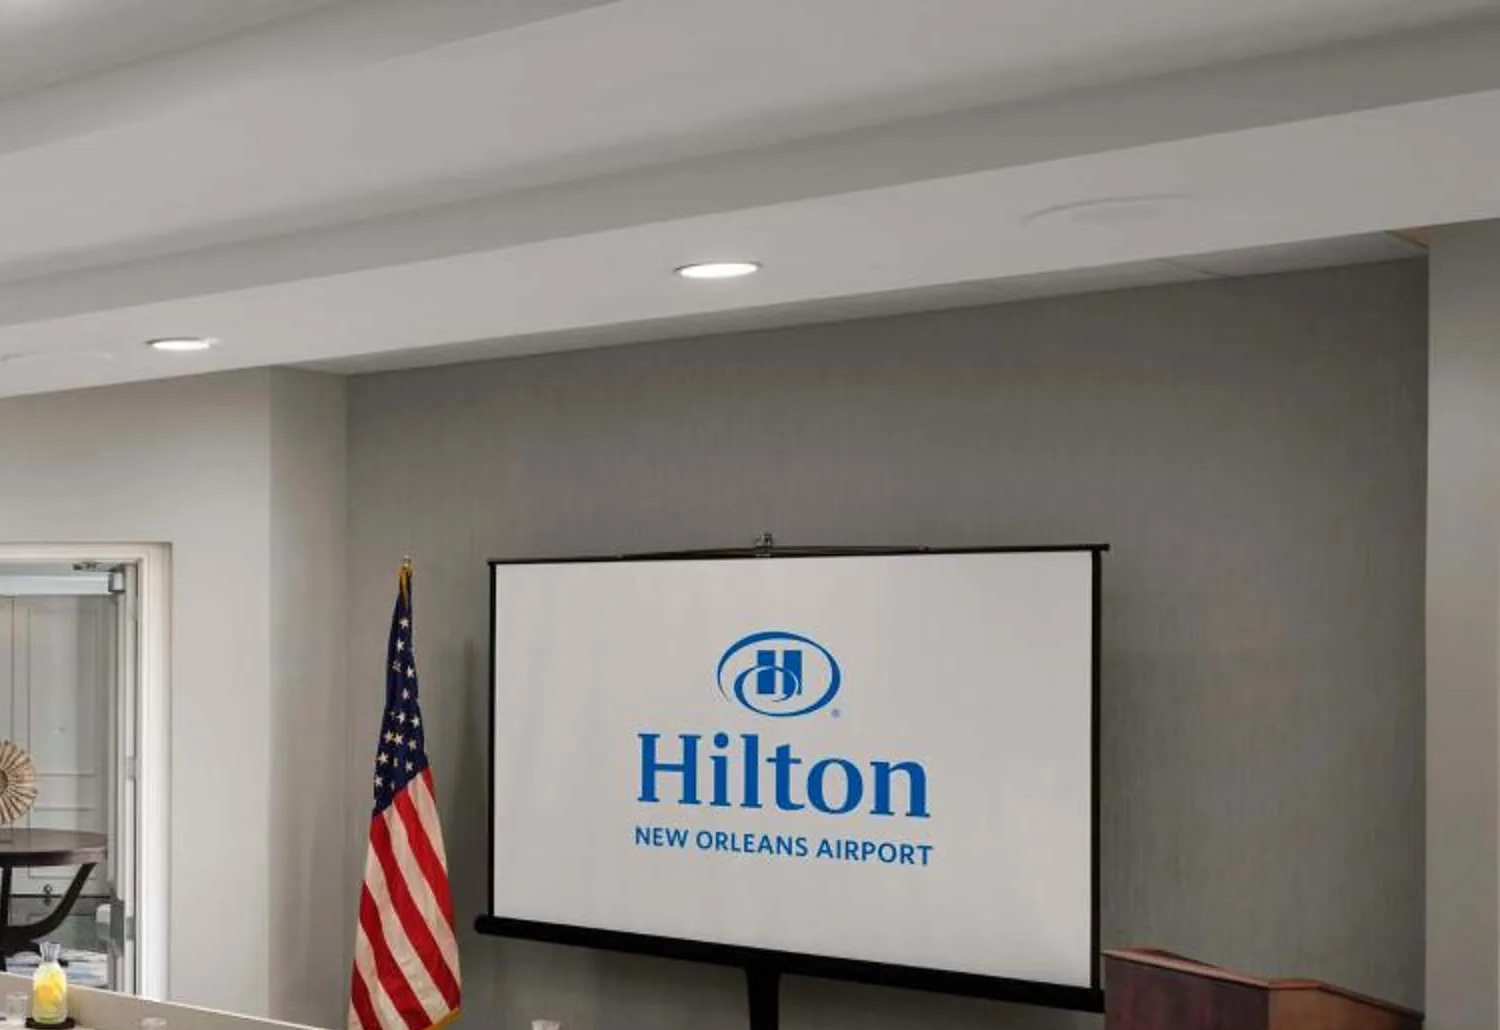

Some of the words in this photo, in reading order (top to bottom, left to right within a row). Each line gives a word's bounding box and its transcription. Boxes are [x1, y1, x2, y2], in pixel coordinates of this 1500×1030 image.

[636, 730, 931, 819] Hilton
[634, 826, 689, 849] NEW
[695, 830, 809, 857] ORLEANS
[815, 838, 933, 866] AIRPORT
